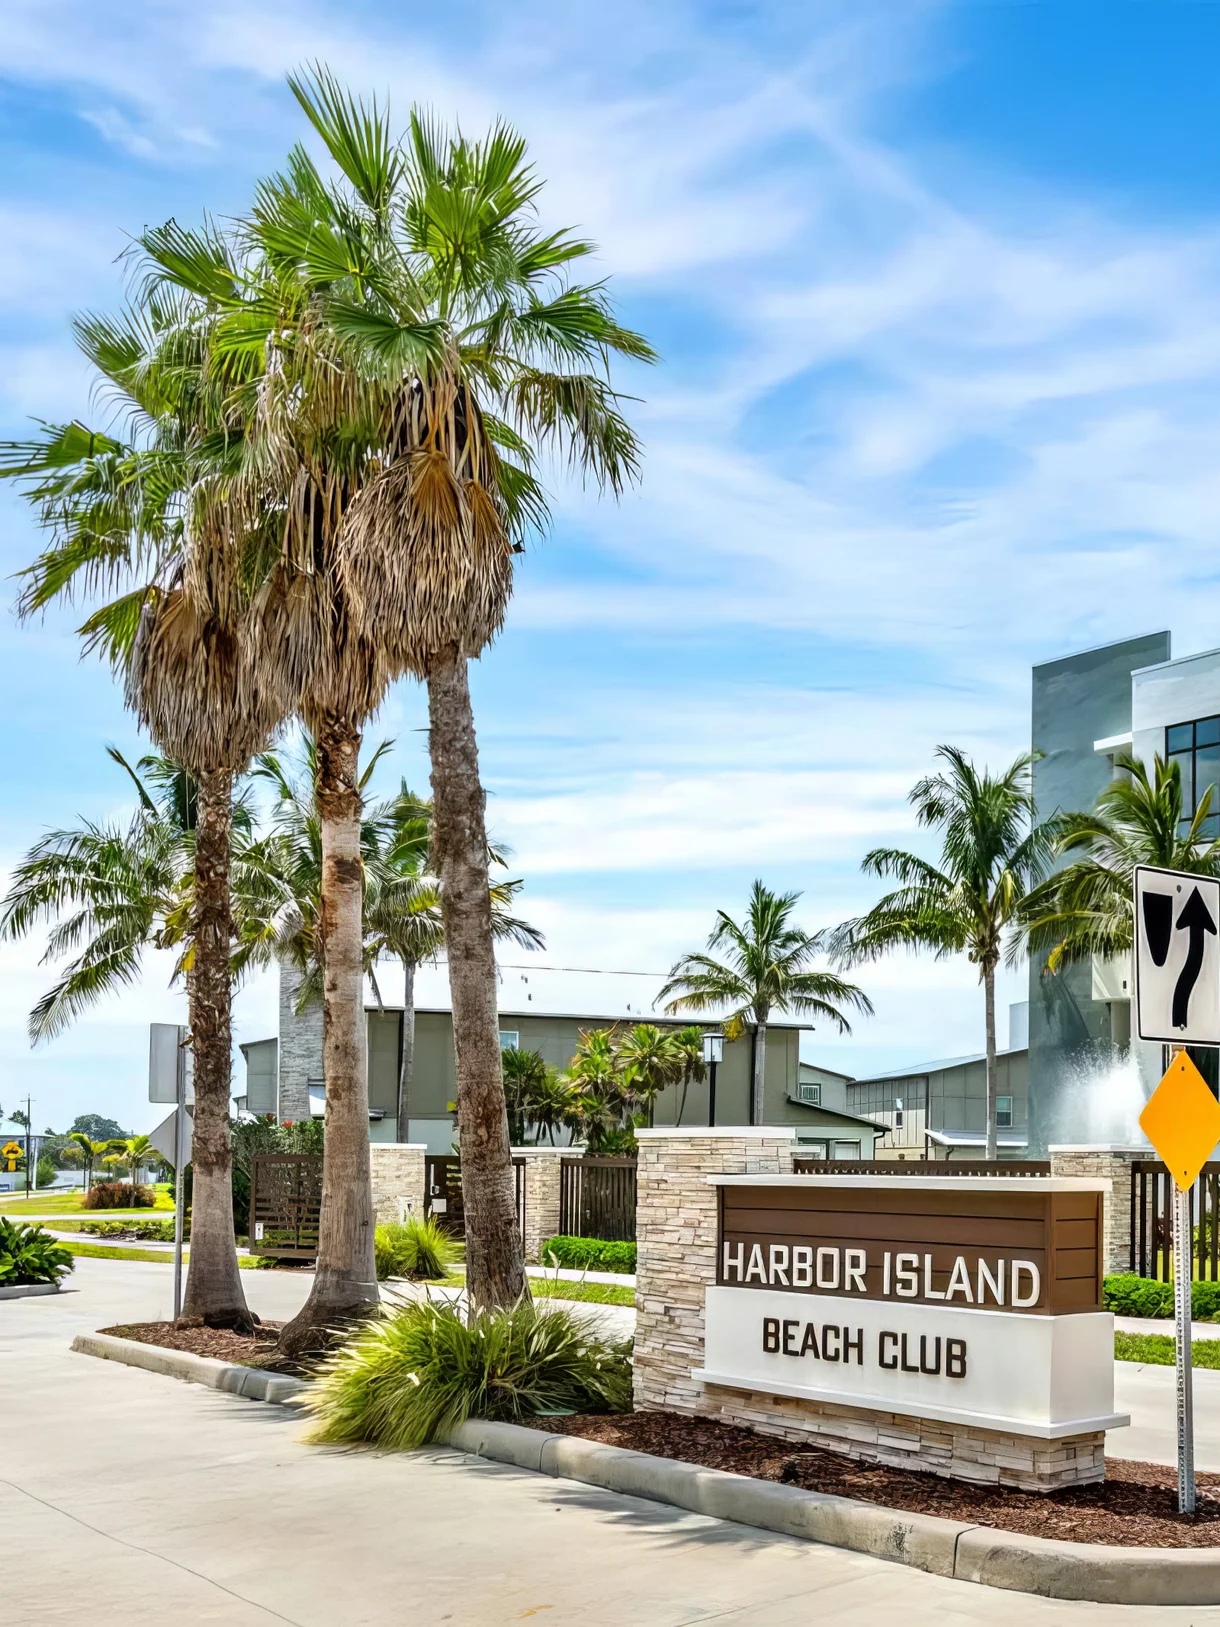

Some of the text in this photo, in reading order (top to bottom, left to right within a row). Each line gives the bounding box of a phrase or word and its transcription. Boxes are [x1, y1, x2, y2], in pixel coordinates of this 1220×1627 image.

[722, 1241, 1041, 1308] HARBOR ISLAND
[763, 1317, 967, 1379] BEACH CLUB
